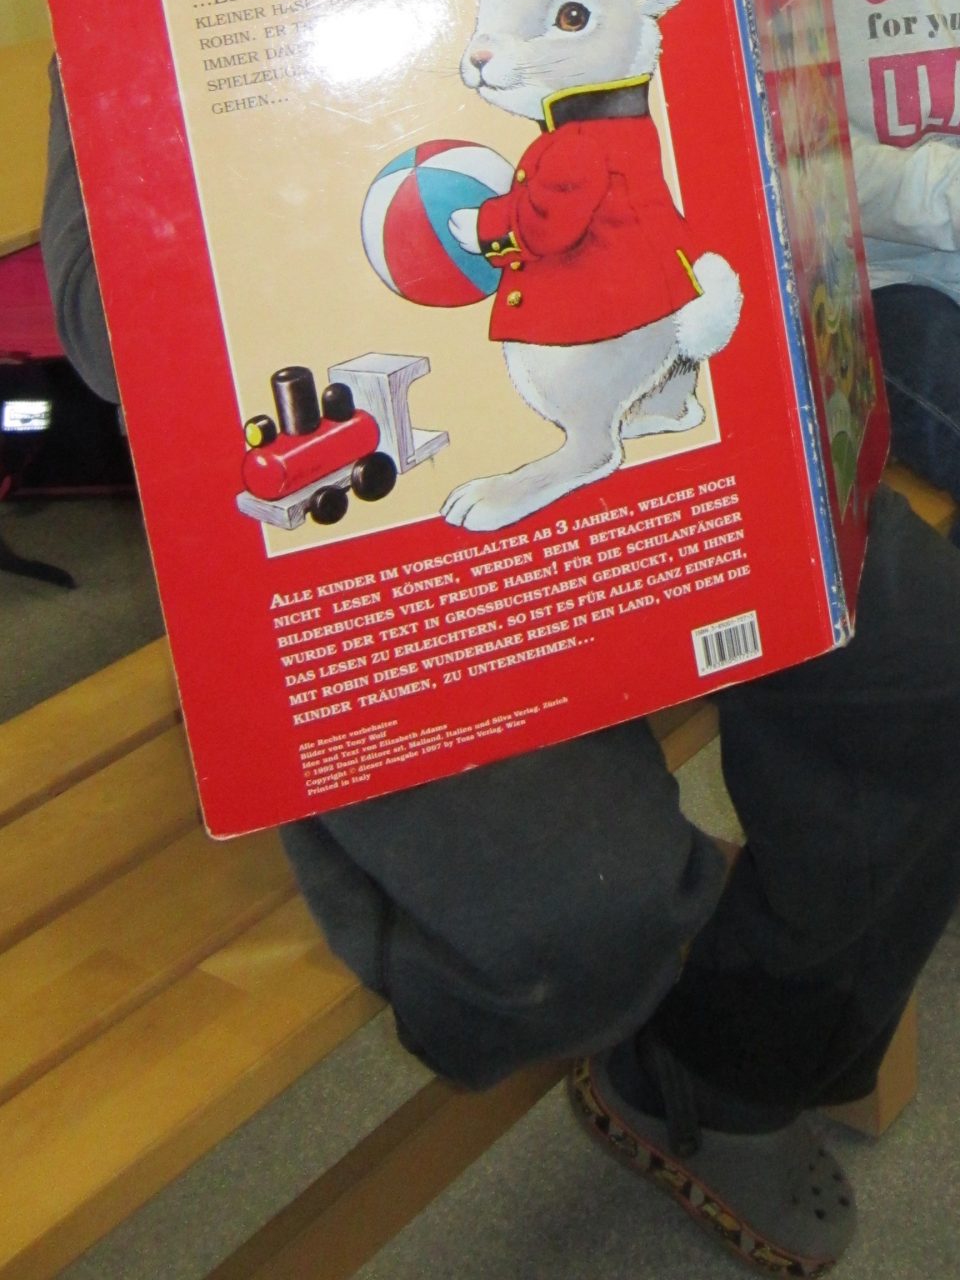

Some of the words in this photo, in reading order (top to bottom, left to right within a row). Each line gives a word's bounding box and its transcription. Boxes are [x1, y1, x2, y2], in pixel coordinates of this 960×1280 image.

[195, 6, 267, 30] KLEINER
[199, 30, 256, 50] ROBIN.
[264, 24, 288, 39] ER
[203, 50, 260, 72] IMMER
[867, 12, 918, 40] for
[211, 93, 289, 115] GEHEN...
[269, 589, 313, 610] ALLE
[316, 573, 376, 597] KINDER
[379, 567, 399, 581] IM
[401, 533, 530, 575] VORSCHULALTER
[532, 527, 552, 542] AB
[555, 519, 569, 535] 3
[572, 505, 634, 531] JAHREN,
[637, 487, 695, 512] WELCHE
[697, 475, 736, 495] NOCH
[273, 606, 321, 629] NICHT
[332, 591, 381, 614] LESEN
[391, 572, 460, 598] KÖNNEN,
[470, 551, 533, 577] WERDEN
[542, 538, 580, 558] BEIM
[588, 510, 681, 545] BETRACHTEN
[690, 493, 739, 516] DIESES
[277, 608, 395, 648] BILDERBUCHES
[399, 598, 435, 615] VIEL
[438, 580, 499, 606] FREUDE
[503, 560, 558, 589] HABEN!
[563, 555, 593, 572] FÜR
[596, 546, 622, 563] DIE
[626, 511, 742, 554] SCHULANFÄNGER
[280, 643, 337, 667] WURDE
[341, 634, 375, 651] DER
[378, 621, 419, 641] TEXT
[423, 616, 440, 630] IN
[444, 575, 587, 624] GROSSBUCHSTABEN
[592, 552, 673, 583] GEDRUCKT,
[677, 542, 700, 557] UM
[703, 528, 744, 550] IHNEN
[284, 669, 316, 687] DAS
[318, 655, 367, 678] LESEN
[370, 649, 390, 664] ZU
[393, 620, 503, 658] ERLEICHTERN.
[506, 612, 527, 627] SO
[529, 604, 553, 621] IST
[555, 598, 575, 613] ES
[577, 590, 606, 607] FÜR
[609, 578, 643, 598] ALLE
[646, 566, 682, 586] GANZ
[684, 548, 747, 575] EINFACH,
[288, 689, 317, 706] MIT
[321, 675, 369, 697] ROBIN
[373, 662, 419, 683] DIESE
[420, 632, 524, 669] WUNDERBARE
[526, 619, 570, 641] REISE
[572, 613, 587, 627] IN
[590, 605, 615, 622] EIN
[618, 594, 660, 614] LAND,
[663, 582, 691, 599] VON
[694, 572, 725, 591] DEM
[727, 564, 751, 580] DIE
[292, 700, 352, 725] KINDER
[357, 678, 437, 707] TRÄUMEN,
[443, 669, 462, 684] ZU
[467, 636, 594, 677] UNTERNEHMEN...
